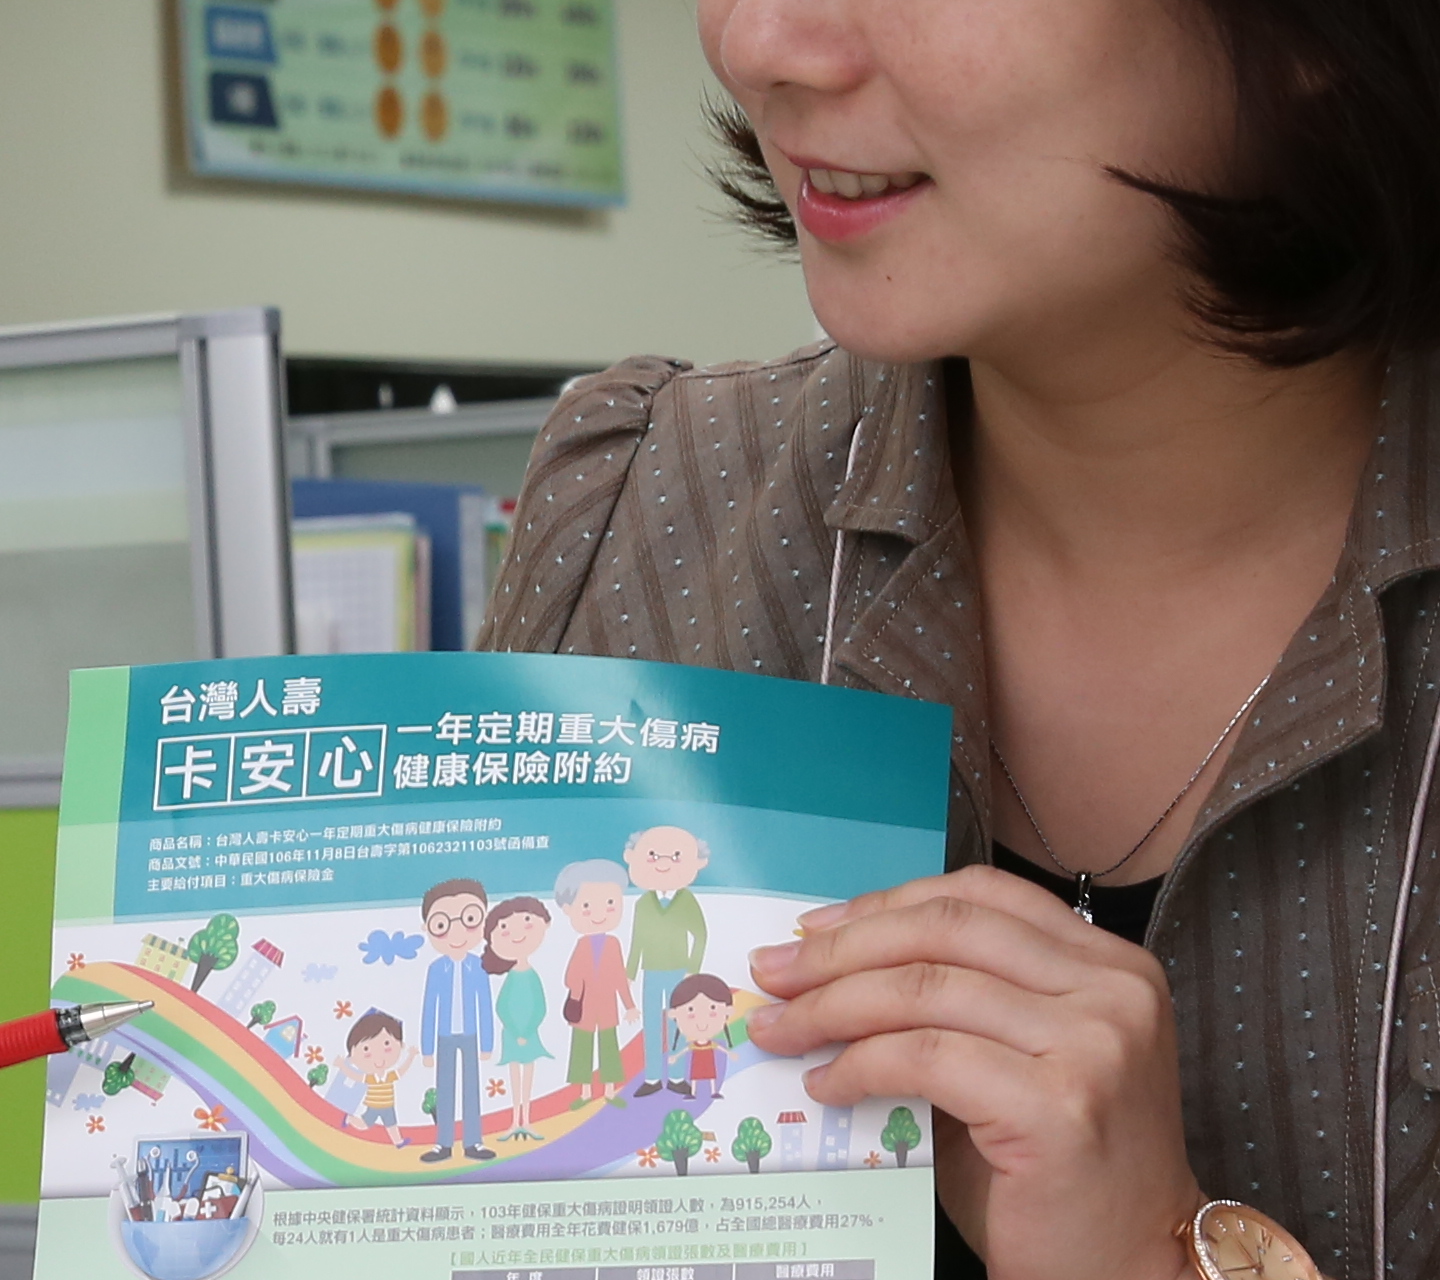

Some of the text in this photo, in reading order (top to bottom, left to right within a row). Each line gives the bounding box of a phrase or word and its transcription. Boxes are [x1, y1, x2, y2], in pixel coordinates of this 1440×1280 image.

[159, 676, 322, 725] 台灣人壽
[396, 710, 721, 754] 一年定期重大傷病
[163, 735, 378, 800] 卡安心
[393, 749, 633, 790] 健康保險附約
[775, 1263, 836, 1279] 醫療費用
